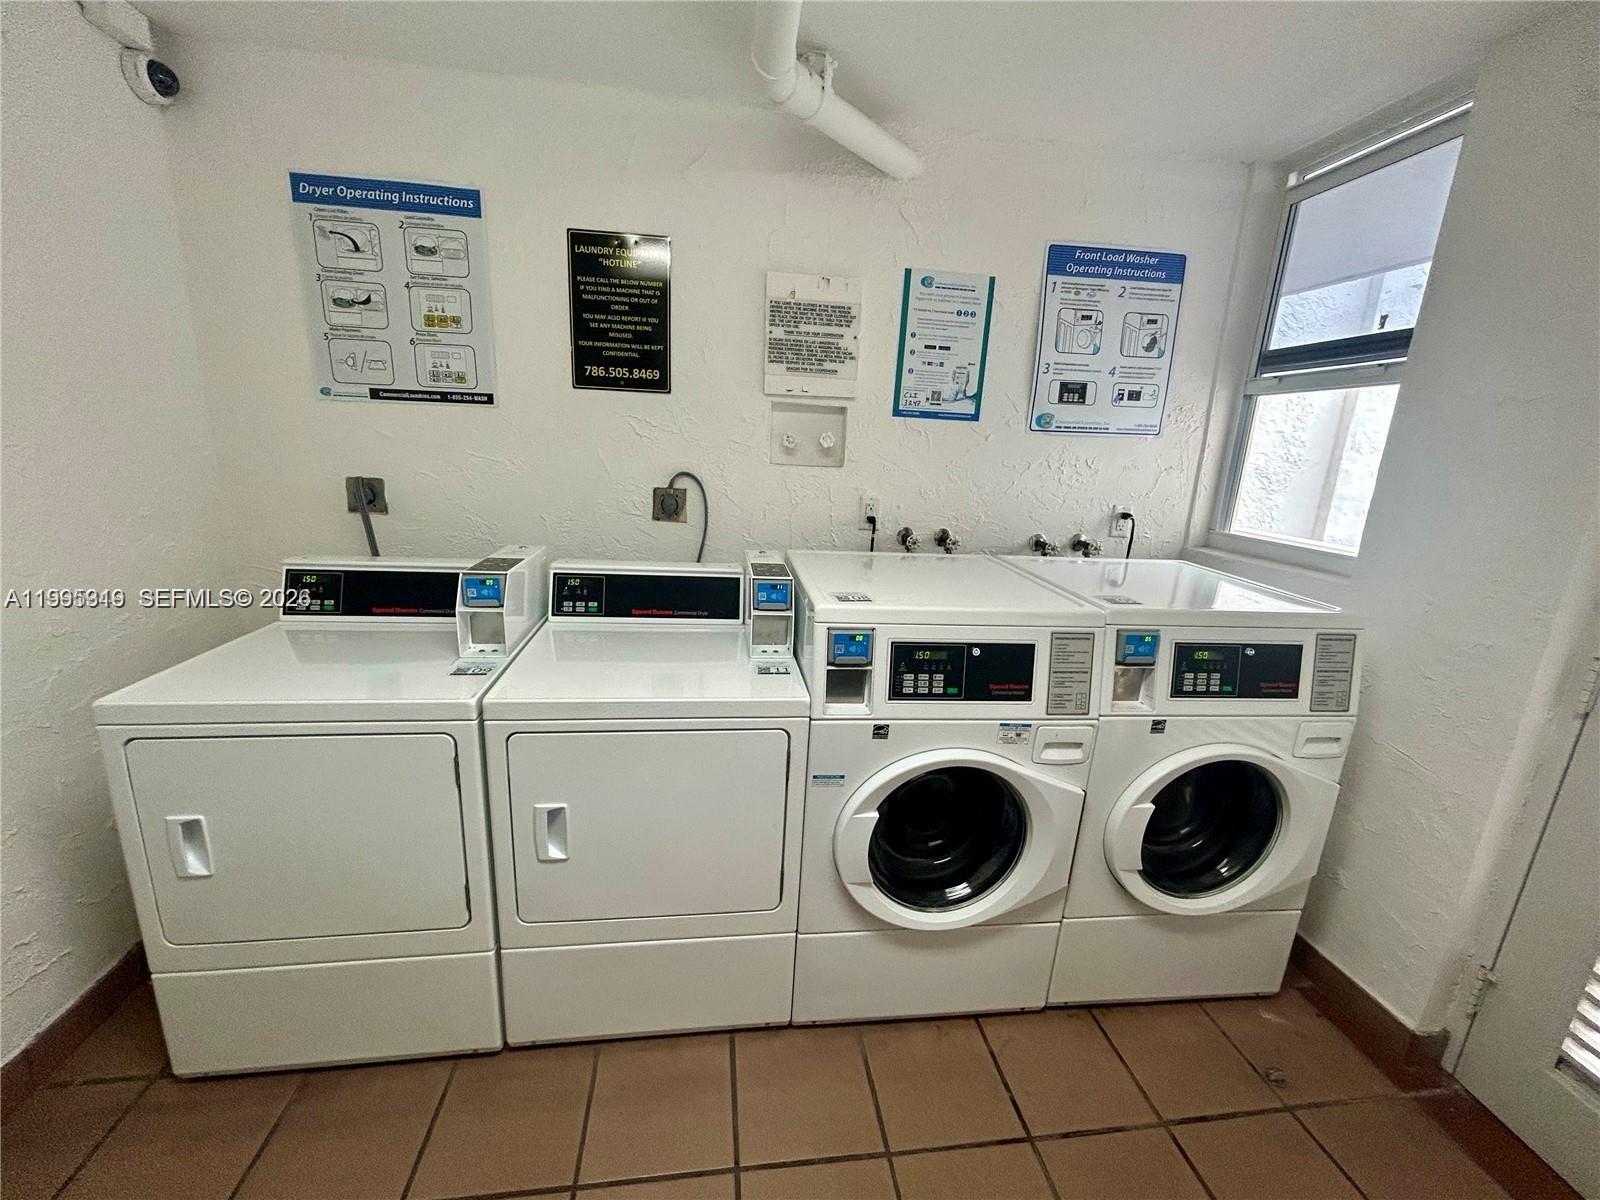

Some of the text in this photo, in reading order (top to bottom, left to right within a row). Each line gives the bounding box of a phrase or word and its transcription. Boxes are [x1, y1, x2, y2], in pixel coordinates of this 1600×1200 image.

[299, 182, 474, 208] Dryer Operating Instructions
[308, 213, 313, 221] 1
[398, 220, 405, 230] 2
[575, 245, 614, 255] LAUNDRY
[1075, 250, 1160, 264] Front Load Washer
[1066, 263, 1166, 279] Operating Instructions
[316, 274, 321, 282] 3
[1052, 282, 1057, 293] 1
[1118, 286, 1127, 298] 2
[582, 294, 629, 302] MALFUNCTIONING
[410, 338, 416, 346] 6
[584, 365, 660, 380] 786.505.8469
[1042, 363, 1050, 374] 3
[1108, 366, 1116, 378] 4
